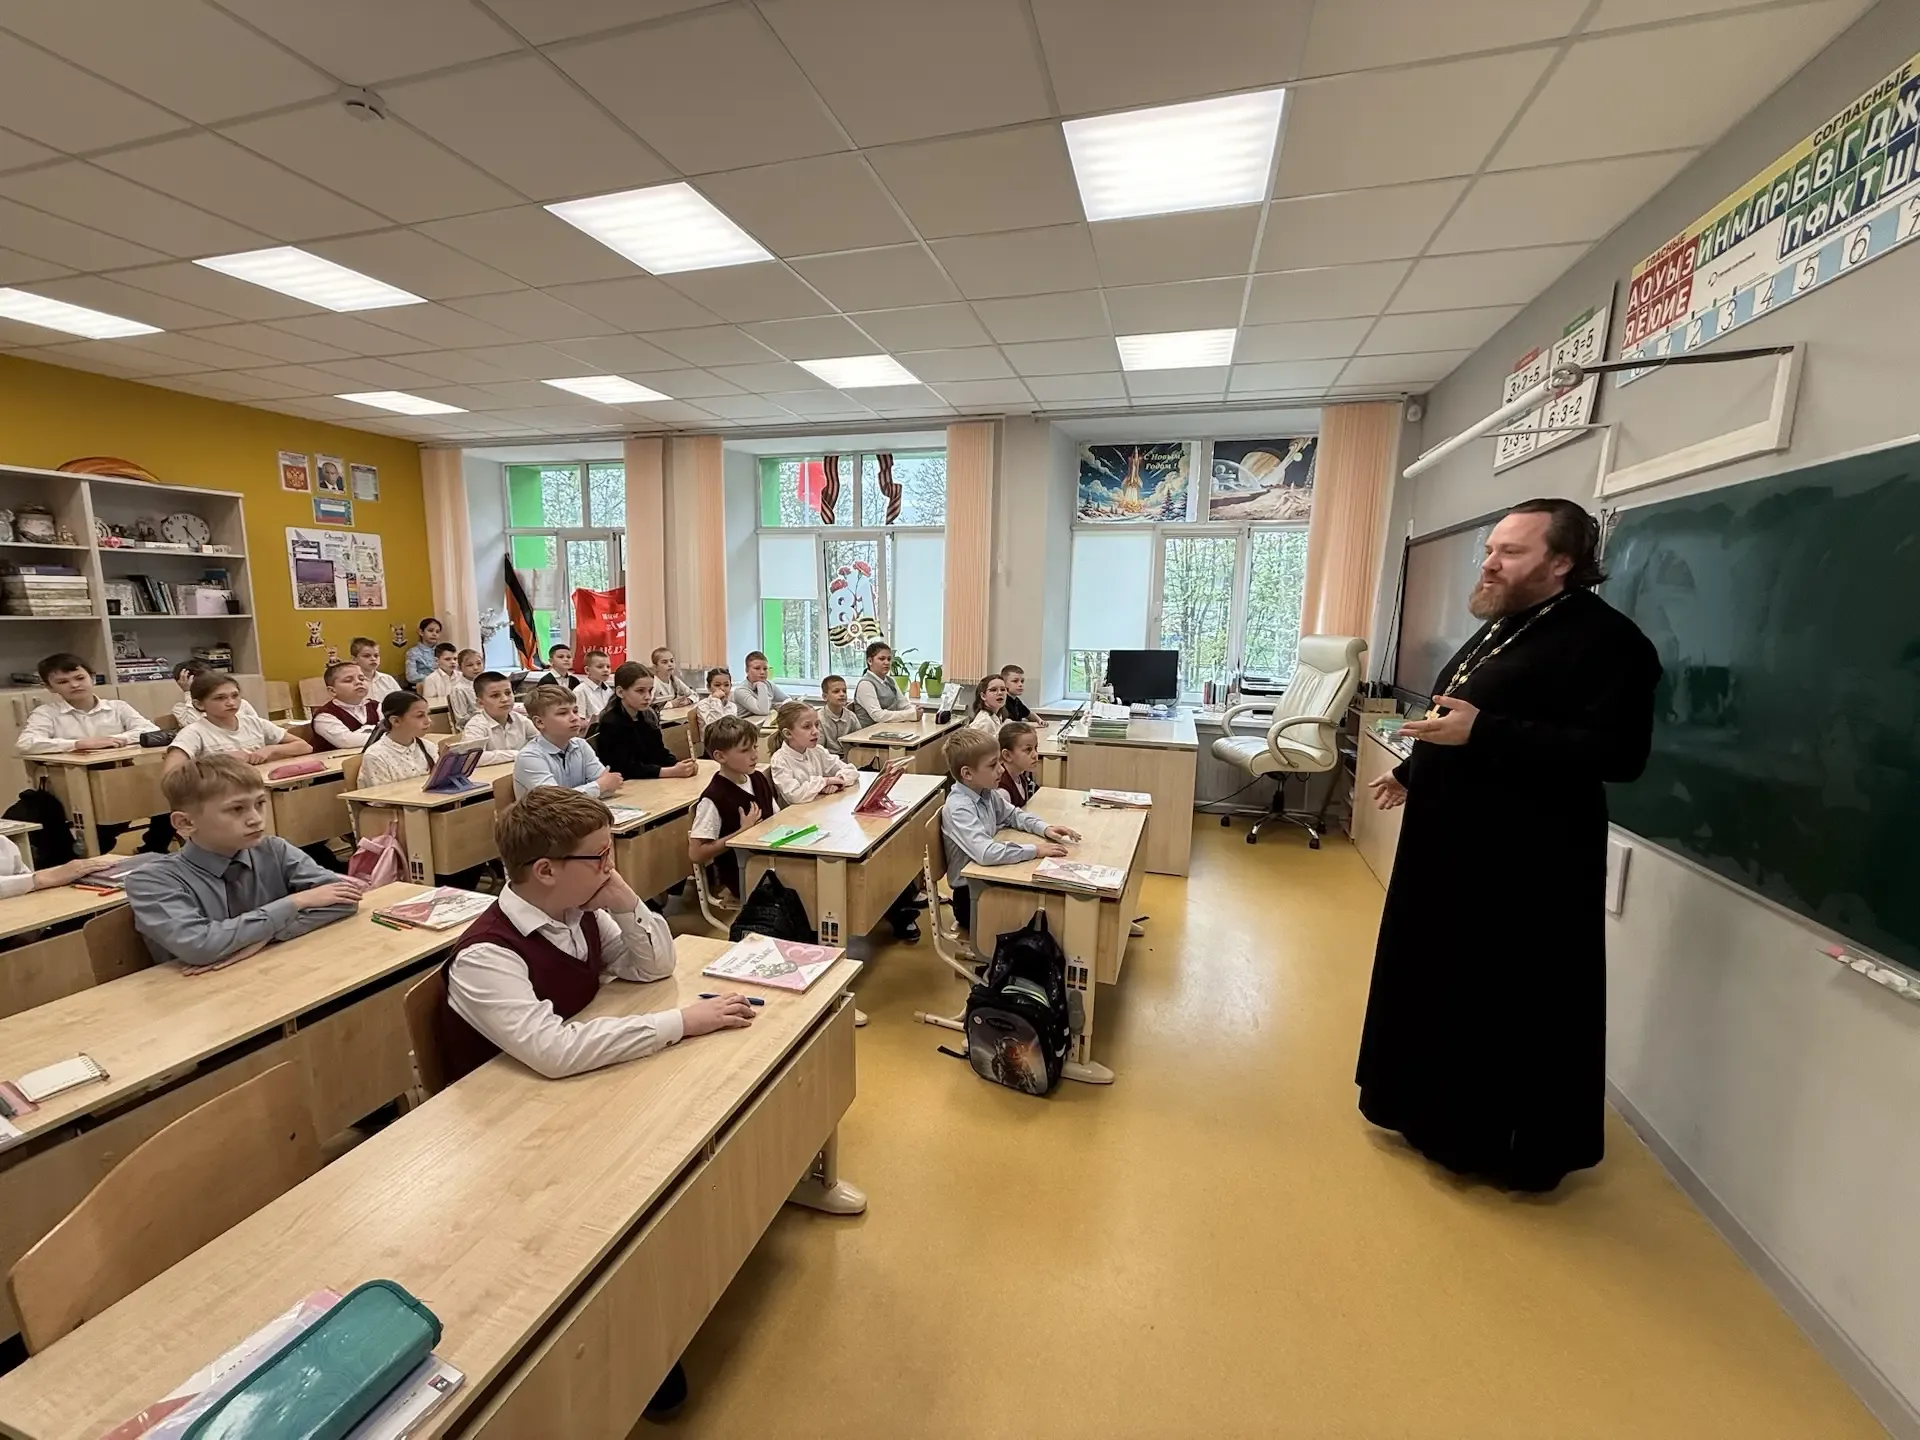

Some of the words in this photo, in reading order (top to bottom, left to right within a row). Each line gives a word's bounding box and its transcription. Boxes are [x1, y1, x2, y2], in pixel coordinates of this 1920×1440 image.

[1812, 63, 1912, 147] СОГЛАСНЫЕ
[1644, 232, 1687, 270] ГЛАСНЫЕ
[1688, 318, 1702, 350] 2
[1720, 299, 1738, 331] 3
[1760, 275, 1775, 310] 4
[1798, 251, 1821, 290] 5
[1849, 223, 1872, 264] 6
[1145, 462, 1171, 470] Годом
